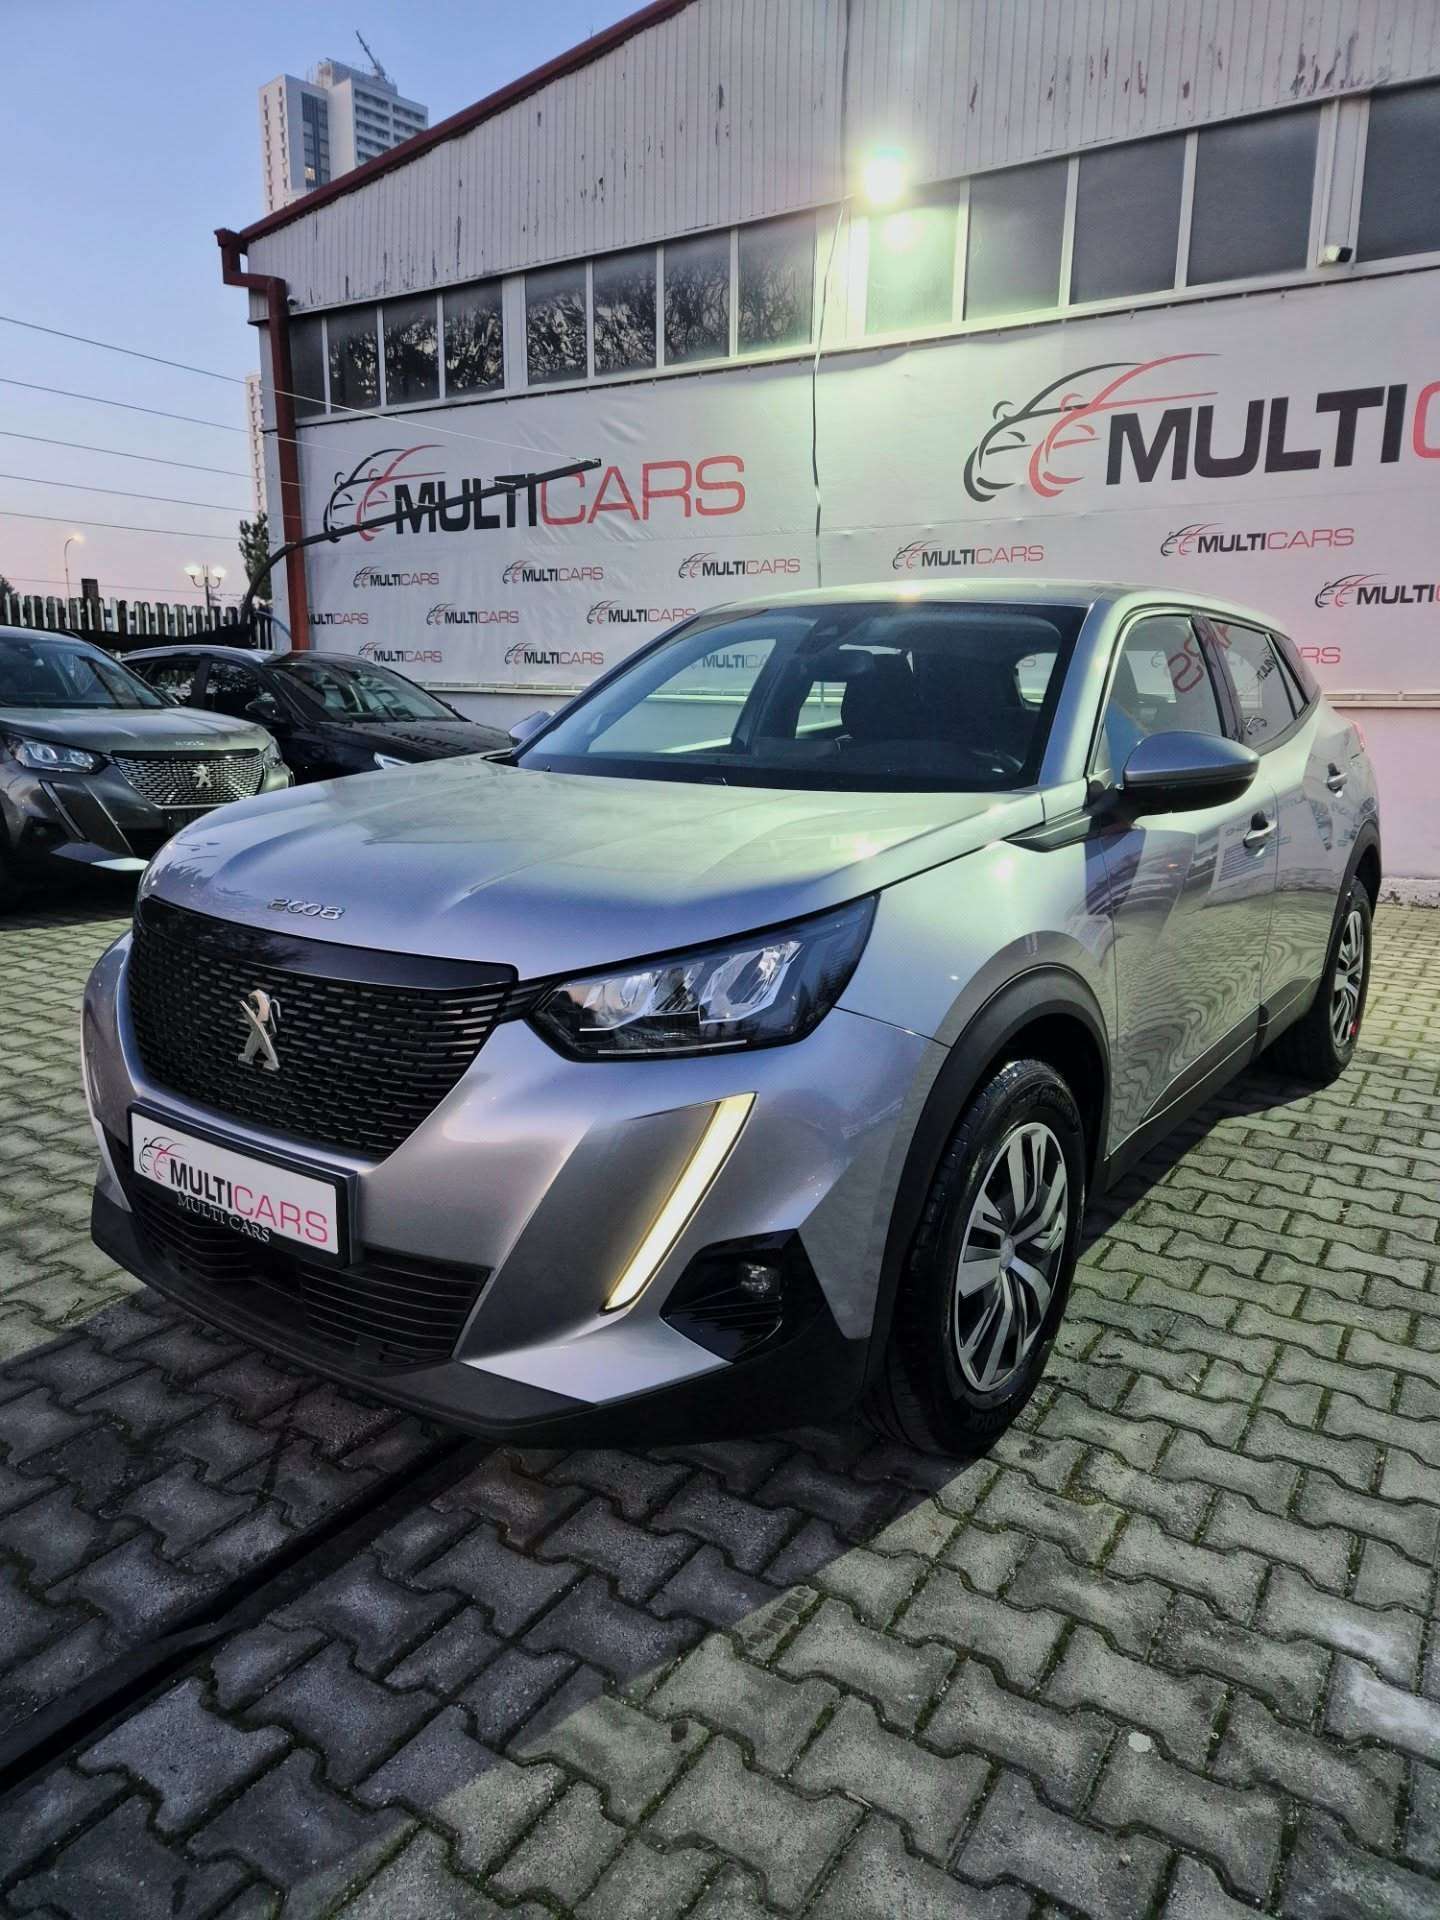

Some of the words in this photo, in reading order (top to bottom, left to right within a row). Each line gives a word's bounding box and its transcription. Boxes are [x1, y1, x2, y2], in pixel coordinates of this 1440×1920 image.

[394, 454, 746, 535] MULTICARS
[1197, 527, 1355, 554] MULTICARS
[921, 544, 1045, 567] MULTICARS
[522, 567, 604, 583] MULTICARS
[702, 558, 801, 577] MULTICARS
[369, 572, 440, 588] MULTICARS
[1356, 583, 1440, 606] MULTI
[444, 610, 520, 625] MULTICARS
[608, 607, 697, 624] MULTICARS
[373, 650, 443, 664] MULTICARS
[524, 651, 604, 666] MULTICARS
[267, 897, 345, 920] 2008
[169, 1157, 329, 1244] MULTICARS
[176, 1192, 226, 1226] MULTI
[228, 1214, 272, 1244] CARS
